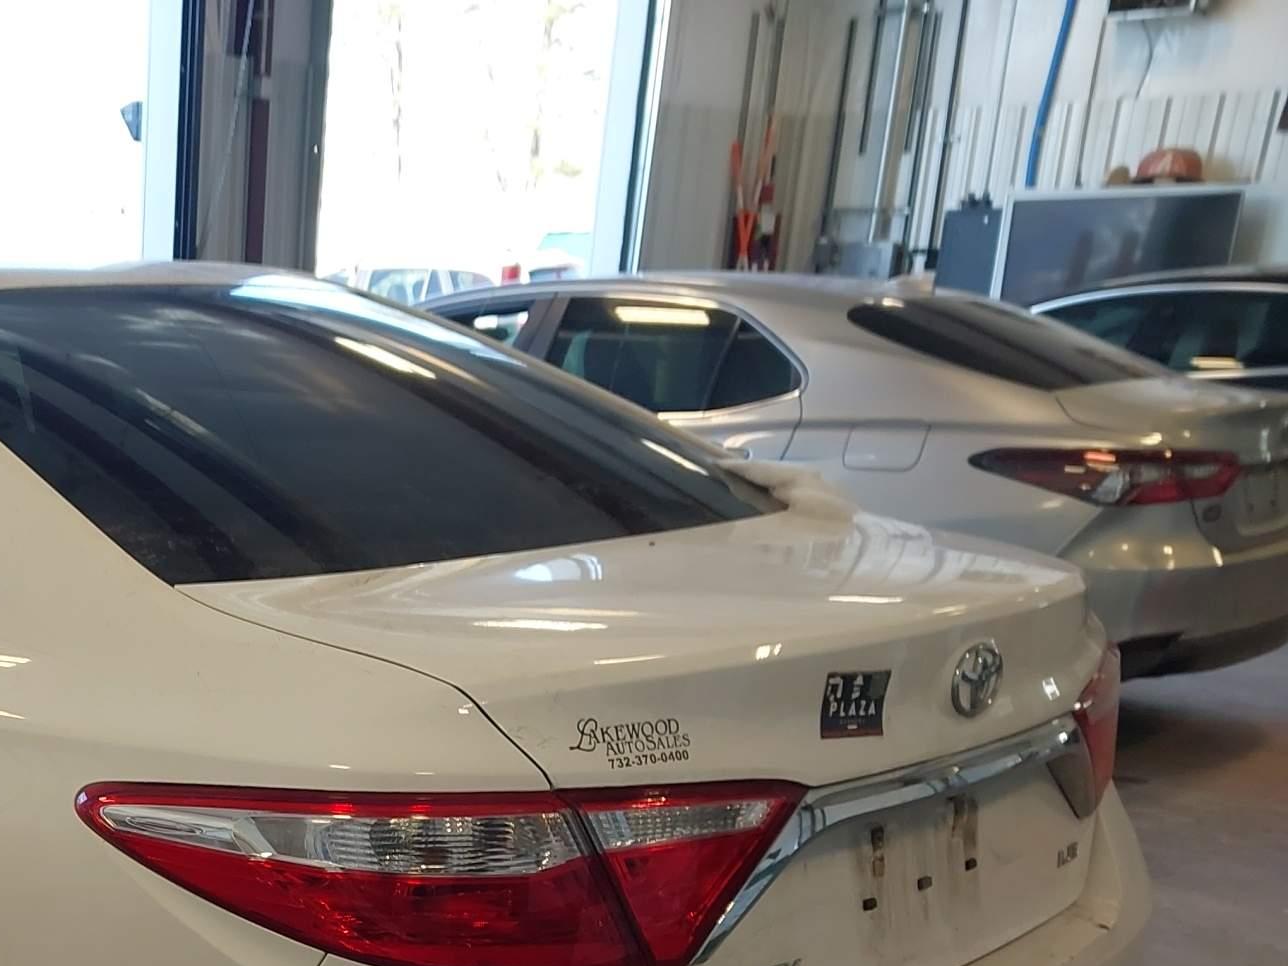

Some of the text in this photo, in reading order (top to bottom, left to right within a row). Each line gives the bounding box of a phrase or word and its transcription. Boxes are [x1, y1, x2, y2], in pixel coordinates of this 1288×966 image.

[828, 699, 876, 718] PLAZA
[569, 718, 680, 752] LAKEWOOD
[608, 749, 690, 770] 732-370-0400
